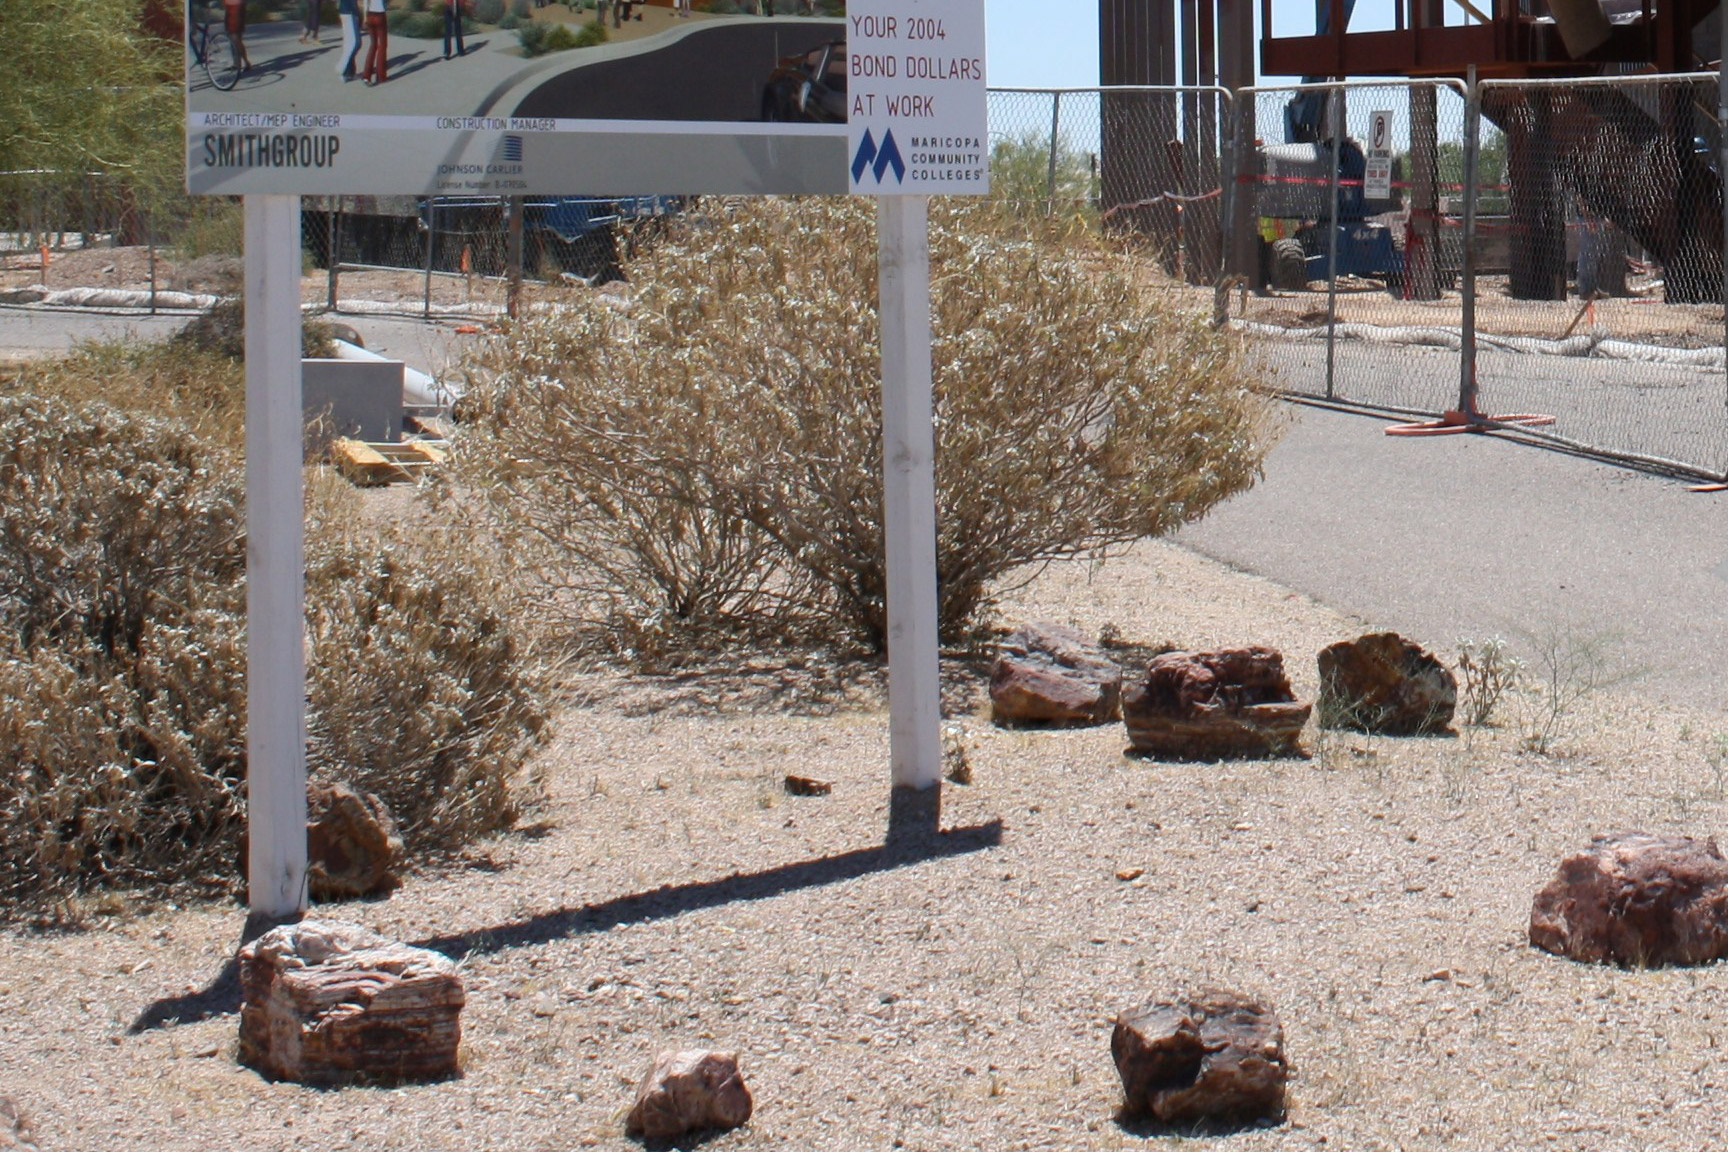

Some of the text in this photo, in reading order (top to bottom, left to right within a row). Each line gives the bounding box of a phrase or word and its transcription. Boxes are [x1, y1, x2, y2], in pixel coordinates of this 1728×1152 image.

[851, 15, 946, 41] YOUR 2004
[851, 54, 982, 81] BOND DOLLARS
[853, 94, 935, 118] AT WORK
[204, 113, 340, 128] ARCHITECT/MEP ENGINEER
[436, 116, 556, 130] CONSTRUCTION MANAGER
[911, 136, 980, 148] MARICOPA
[204, 133, 340, 168] SMITHGROUP
[911, 153, 980, 165] COMMUNITY
[437, 164, 523, 176] JOHNSON CARLIER
